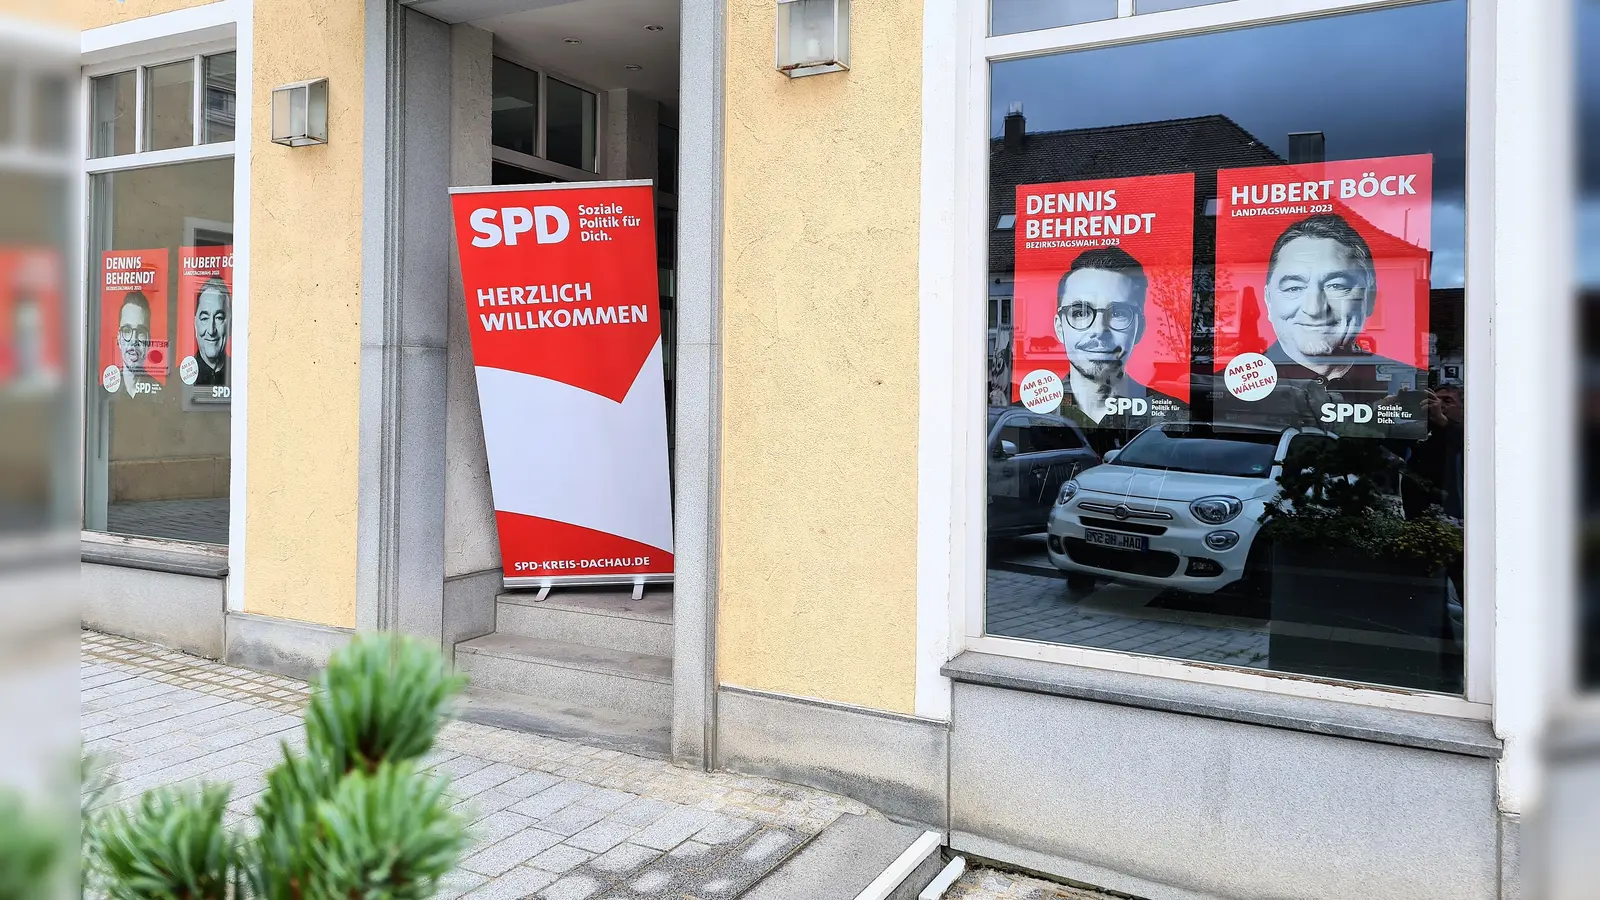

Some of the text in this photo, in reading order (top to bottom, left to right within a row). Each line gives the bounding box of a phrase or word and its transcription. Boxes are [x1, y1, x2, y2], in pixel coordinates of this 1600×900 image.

[1231, 172, 1416, 205] HUBERT BÖCK
[578, 203, 623, 215] Soziale
[1026, 189, 1117, 215] DENNIS
[1231, 204, 1333, 217] LANDTAGSWAHL 2023
[469, 205, 570, 248] SPD
[579, 215, 641, 229] Politik für
[1026, 213, 1156, 239] BEHRENDT
[580, 231, 612, 242] Dich.
[1025, 238, 1120, 249] BEZIRKSTAGSWAHL 2023
[106, 256, 142, 270] DENNIS
[183, 256, 221, 269] HUBERT
[106, 271, 155, 285] BEHRENDT
[476, 282, 592, 307] HERZLICH
[479, 304, 648, 332] WILLKOMMEN
[1228, 359, 1267, 377] AM 8.10.
[1023, 375, 1055, 391] AM 8.10.
[1241, 372, 1259, 382] SPD
[136, 382, 151, 394] SPD
[212, 386, 230, 398] SPD
[1033, 386, 1049, 396] SPD
[1232, 376, 1275, 396] WÄHLEN!
[1026, 391, 1062, 408] WÄHLEN!
[1104, 397, 1148, 416] SPD
[1320, 402, 1373, 424] SPD
[514, 556, 650, 571] SPD-KREIS-DACHAU.DE
